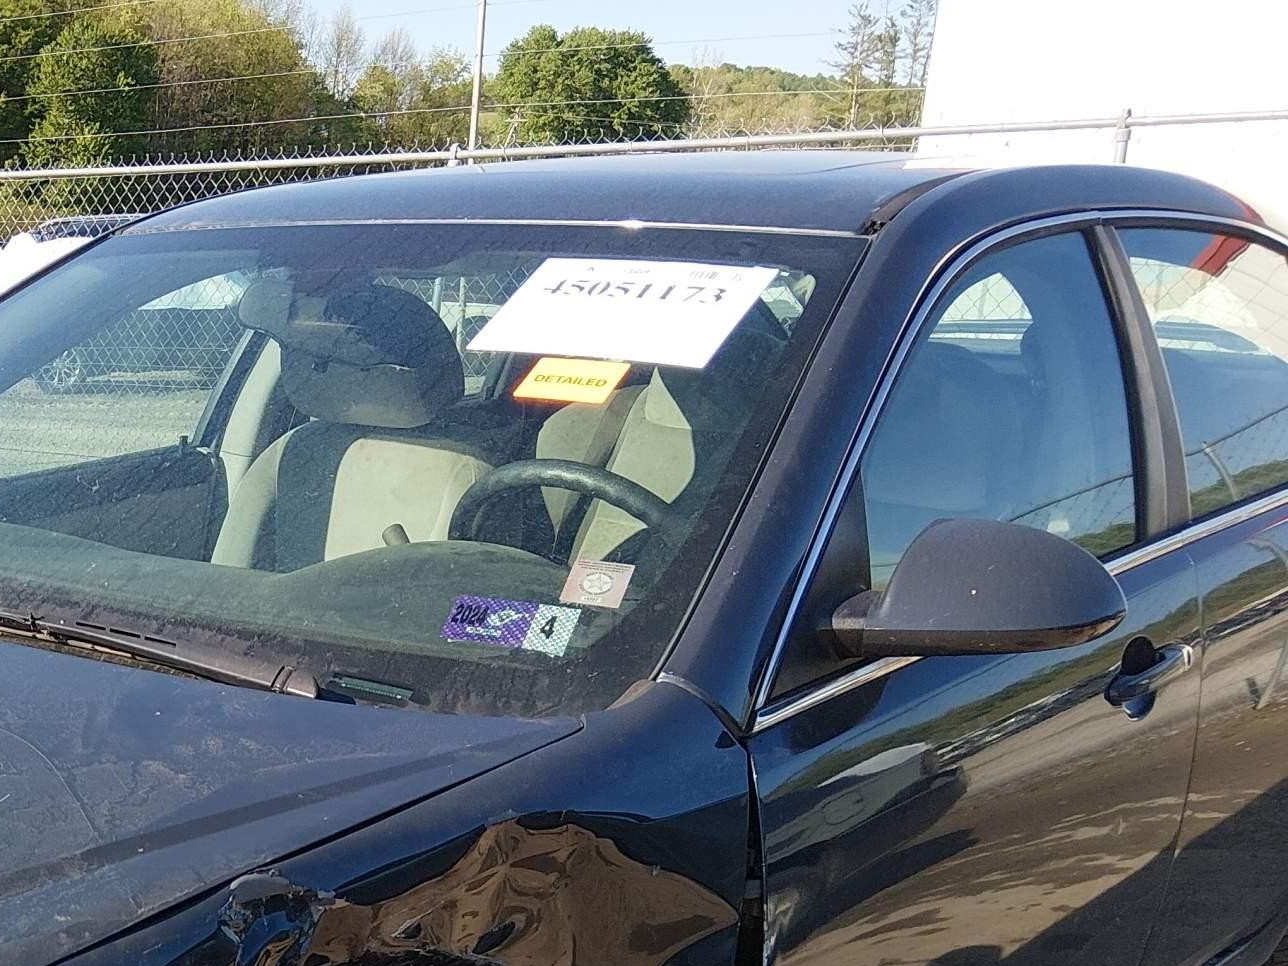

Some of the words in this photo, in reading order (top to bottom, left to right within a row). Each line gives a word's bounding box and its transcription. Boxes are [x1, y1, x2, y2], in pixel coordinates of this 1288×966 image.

[543, 279, 728, 303] 45051173
[533, 373, 608, 388] DETAILED
[450, 603, 491, 626] 2024
[539, 615, 558, 640] 4
